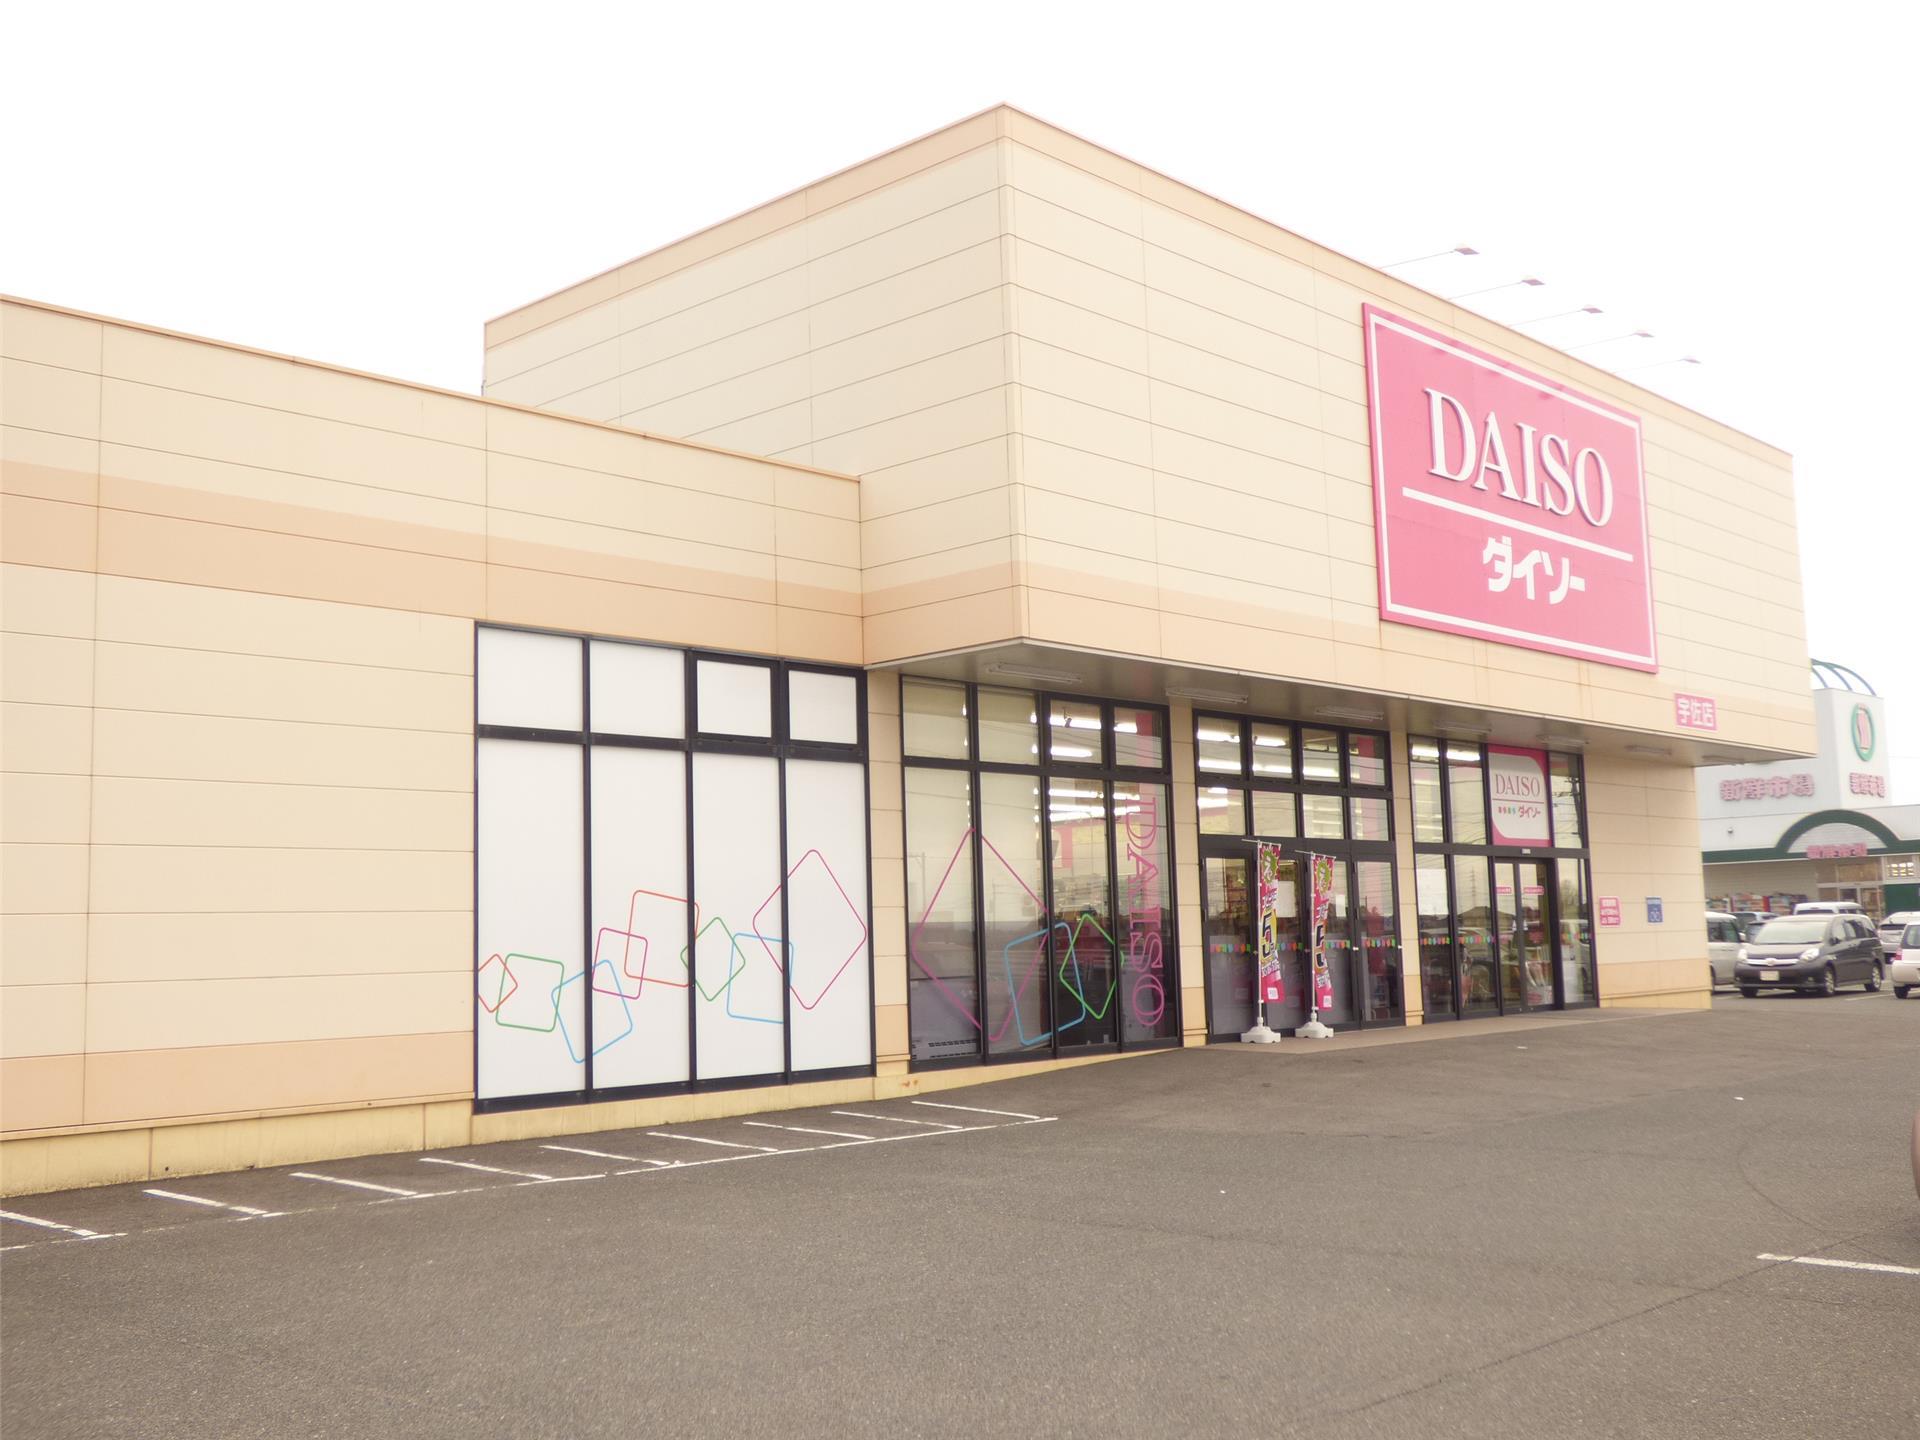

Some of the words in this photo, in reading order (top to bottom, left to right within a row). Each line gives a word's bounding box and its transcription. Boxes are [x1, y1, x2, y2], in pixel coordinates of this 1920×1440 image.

[1423, 387, 1614, 528] DAISO
[1482, 536, 1586, 605] ダイソー
[1495, 774, 1540, 797] DAISO
[1720, 774, 1815, 801] 新鮮市場
[1519, 805, 1541, 818] ダイソー
[1125, 797, 1164, 1026] DAISO
